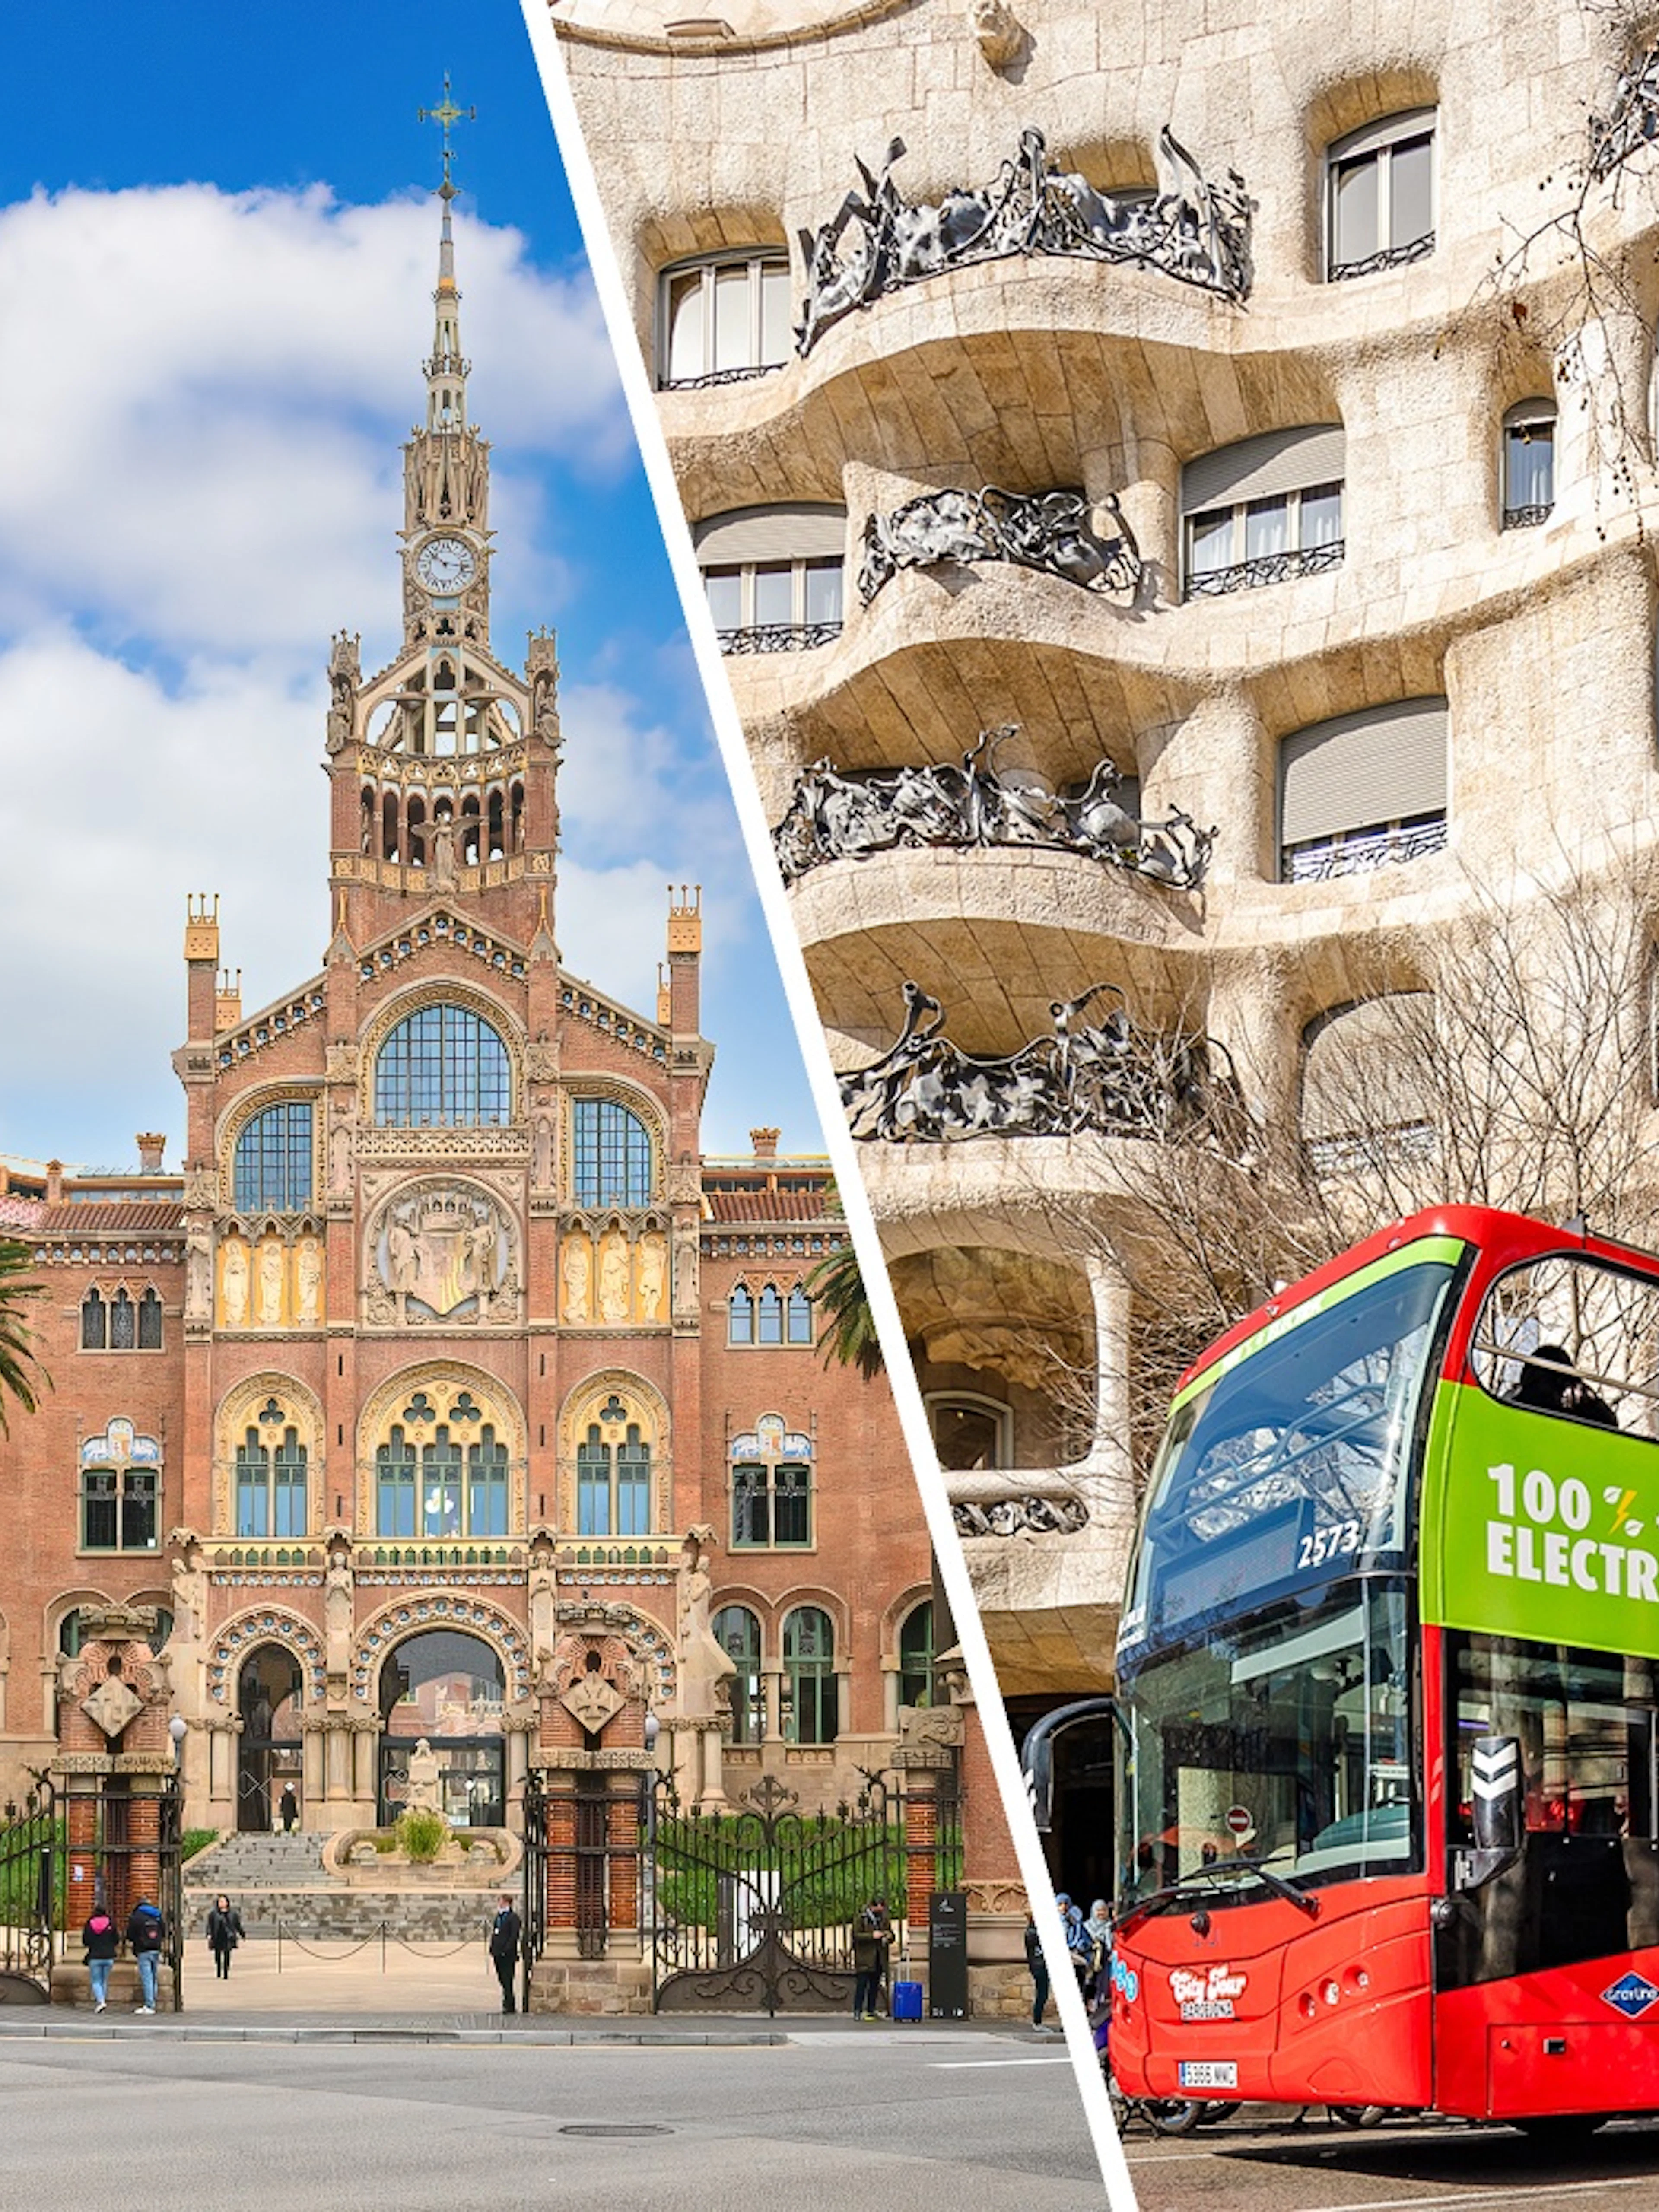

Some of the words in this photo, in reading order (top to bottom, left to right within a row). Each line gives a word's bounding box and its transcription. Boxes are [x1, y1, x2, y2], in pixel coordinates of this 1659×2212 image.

[1487, 1463, 1592, 1532] 100
[1297, 1519, 1360, 1570] 2573
[1487, 1520, 1659, 1603] ELECTR
[1170, 1971, 1206, 2005] City
